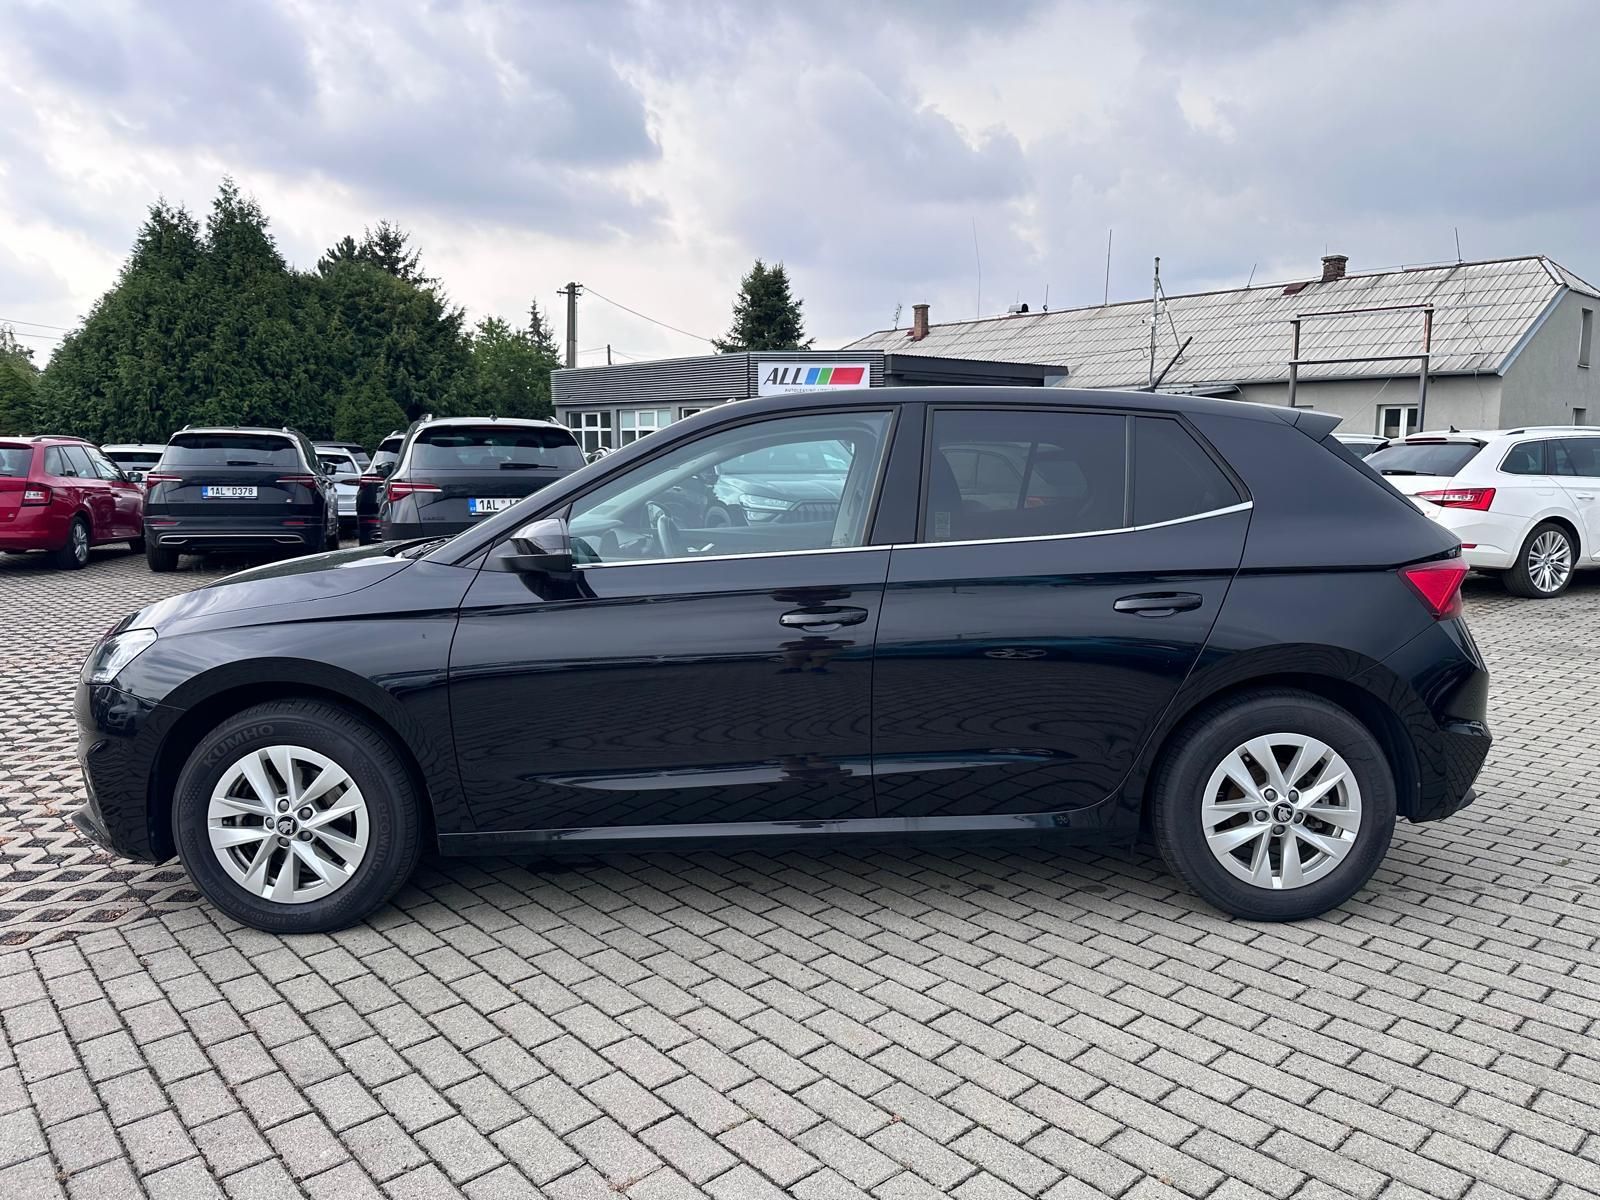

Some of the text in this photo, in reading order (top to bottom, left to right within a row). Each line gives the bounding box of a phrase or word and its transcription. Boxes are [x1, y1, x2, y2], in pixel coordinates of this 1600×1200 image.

[763, 367, 803, 385] ALL
[209, 487, 254, 496] 1AL 0378
[479, 499, 499, 511] 1AL
[203, 724, 274, 768] KUMHO
